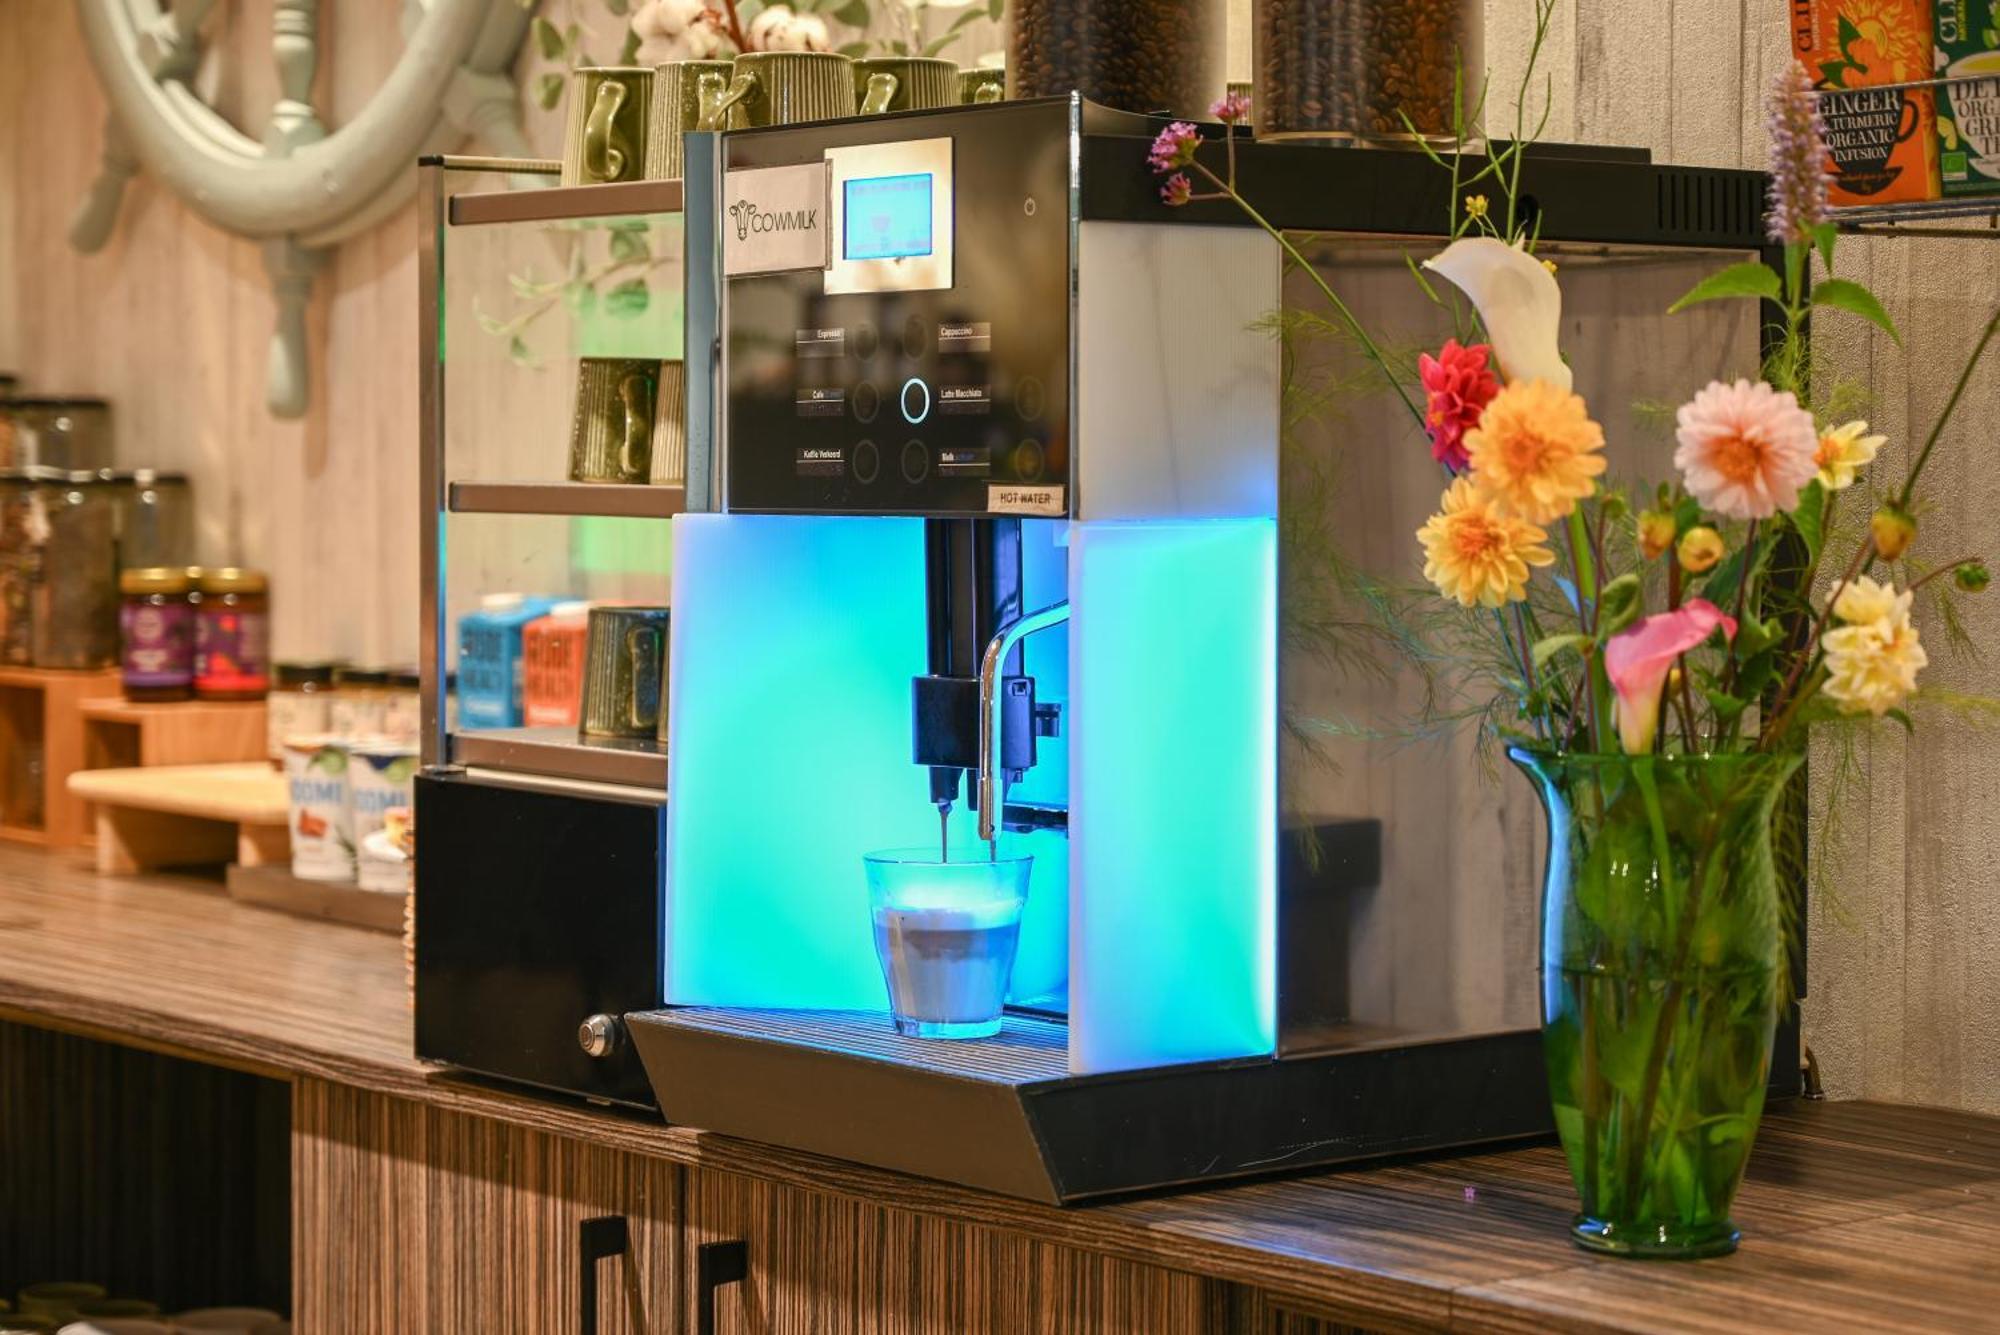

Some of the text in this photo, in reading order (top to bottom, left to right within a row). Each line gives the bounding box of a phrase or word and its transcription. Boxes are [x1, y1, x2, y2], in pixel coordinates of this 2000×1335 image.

[1958, 99, 2000, 118] ORG
[1831, 112, 1897, 130] TURMERIC
[1826, 129, 1895, 149] ORGANIC
[1835, 146, 1887, 163] INFUSION
[751, 208, 816, 233] COWMILK
[1000, 491, 1051, 505] HOT WATER
